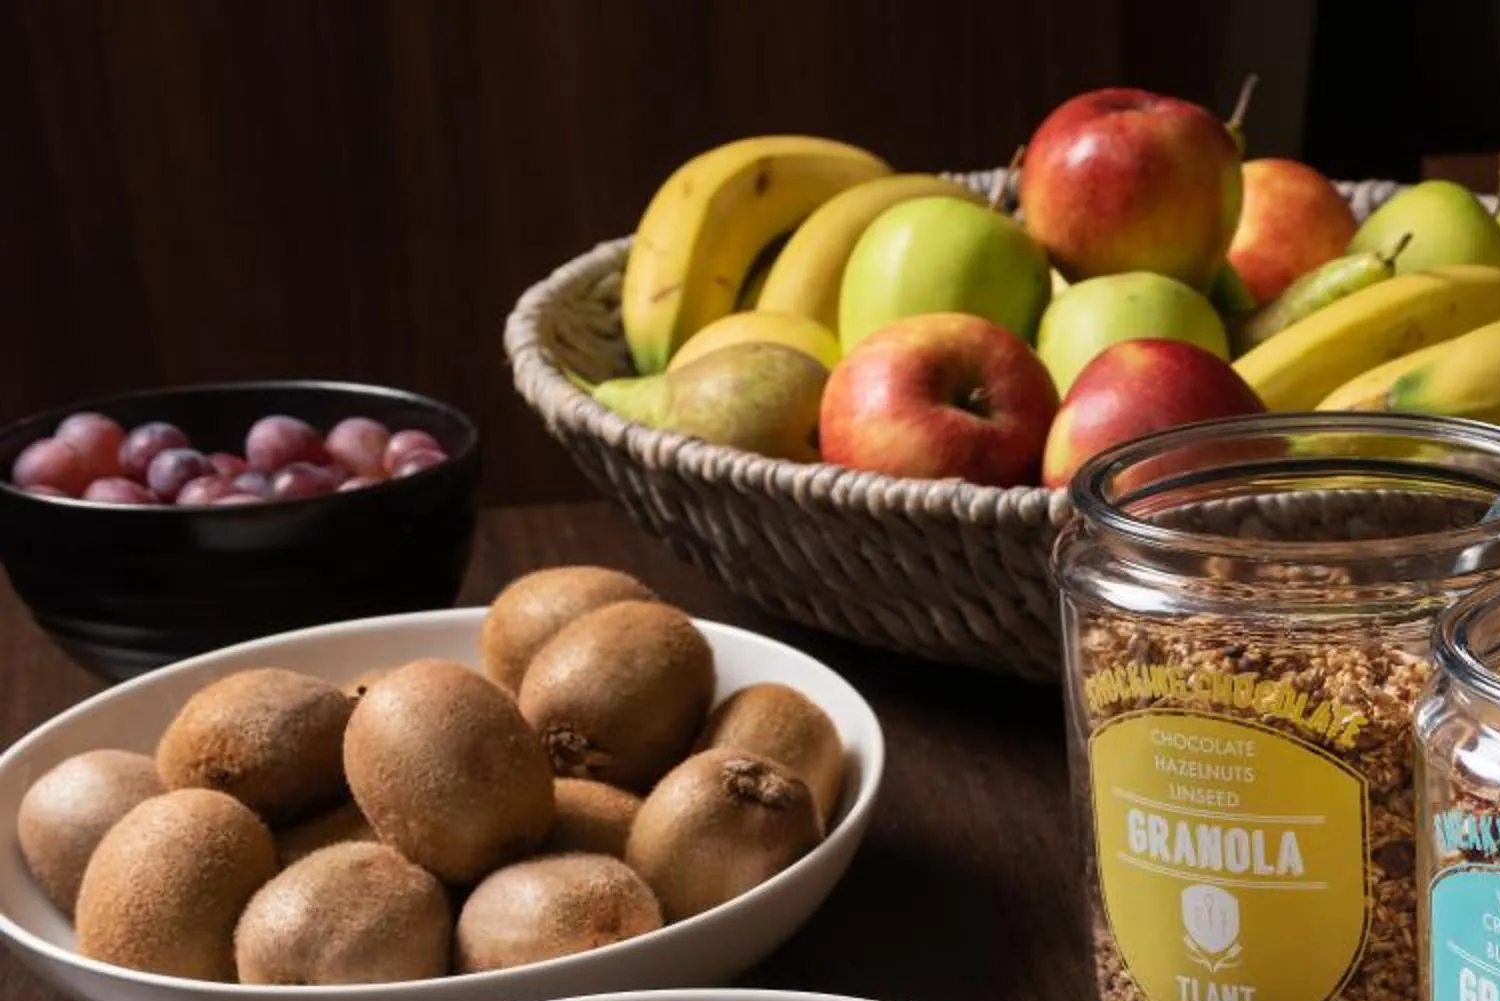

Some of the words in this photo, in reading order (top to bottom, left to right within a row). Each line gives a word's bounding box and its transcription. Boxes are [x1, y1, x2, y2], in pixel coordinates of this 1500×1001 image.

[1151, 728, 1256, 757] CHOCOLATE
[1154, 755, 1256, 783] HAZELNUTS
[1168, 783, 1240, 808] LINSEED
[1127, 808, 1305, 876] GRANOLA
